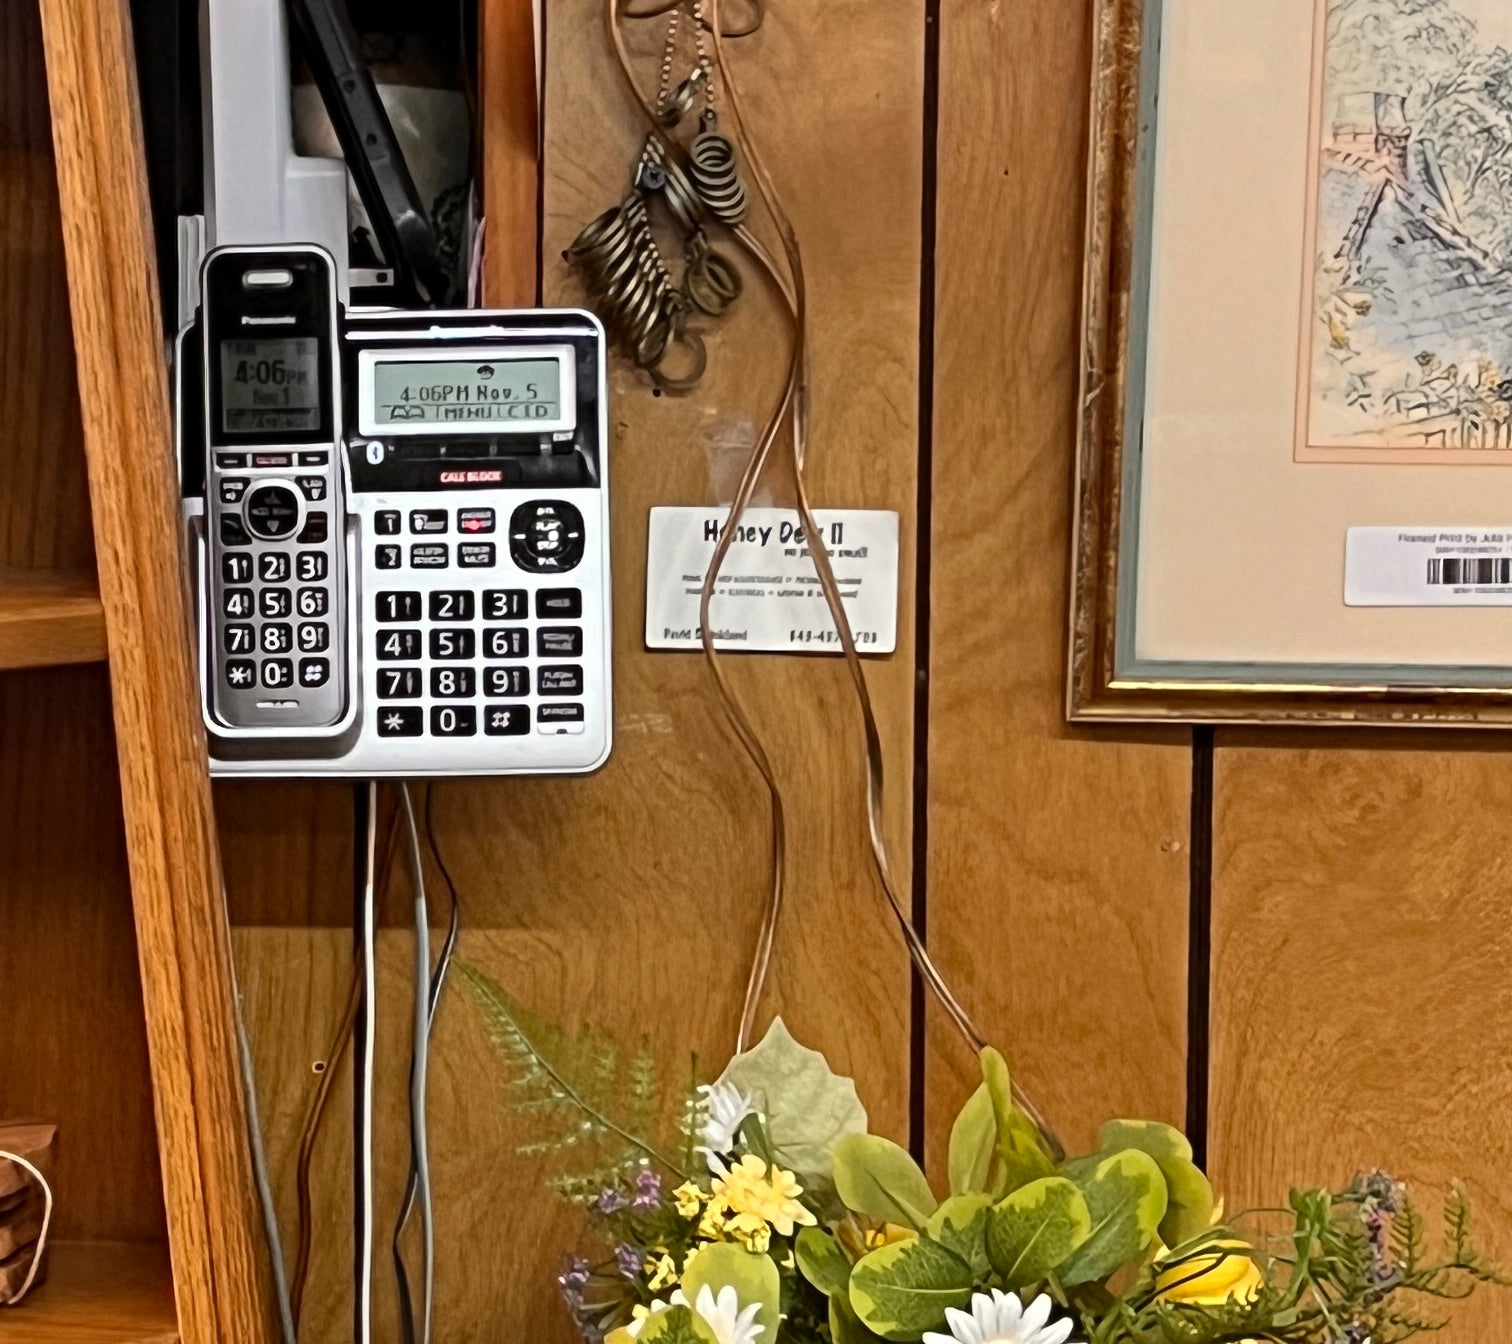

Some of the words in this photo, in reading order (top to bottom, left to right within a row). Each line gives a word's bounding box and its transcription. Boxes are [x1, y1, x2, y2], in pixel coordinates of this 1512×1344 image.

[400, 384, 470, 403] 4:06PM
[476, 383, 519, 402] Nov.
[526, 383, 538, 400] 5
[440, 471, 465, 483] CALL
[466, 470, 503, 482] BLOCK
[228, 558, 238, 580] 1
[264, 556, 279, 580] 2
[301, 556, 316, 579] 3
[227, 593, 243, 616] 4
[265, 592, 280, 615] 5
[300, 591, 316, 614] 6
[387, 594, 397, 618] 1
[438, 594, 454, 617] 2
[492, 593, 508, 616] 3
[228, 628, 243, 651] 7
[264, 627, 280, 651] 8
[300, 625, 317, 650] 9
[384, 632, 402, 656] 4
[438, 632, 454, 656] 5
[492, 631, 509, 654] 6
[264, 662, 281, 685] 0
[385, 671, 402, 696] 7
[439, 670, 456, 694] 8
[492, 670, 509, 694] 9
[439, 708, 456, 732] 0
